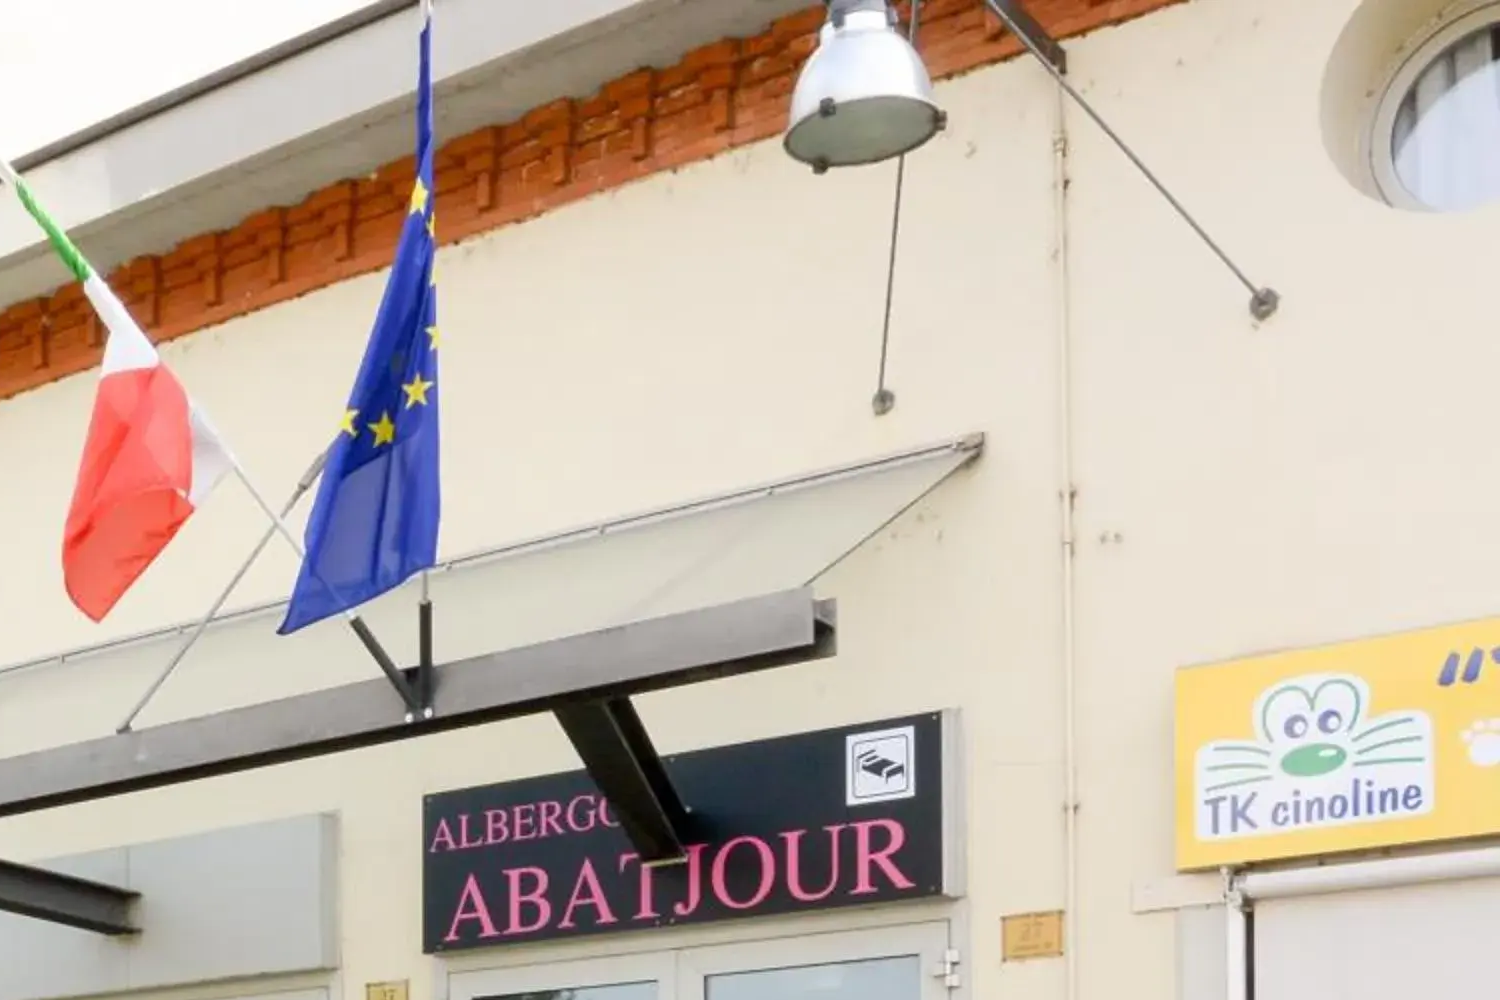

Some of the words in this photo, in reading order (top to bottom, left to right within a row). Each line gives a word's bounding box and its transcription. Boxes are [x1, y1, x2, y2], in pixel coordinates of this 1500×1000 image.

[1204, 791, 1258, 834] TK
[1270, 778, 1424, 826] cinoline
[445, 817, 915, 942] ABATJOUR
